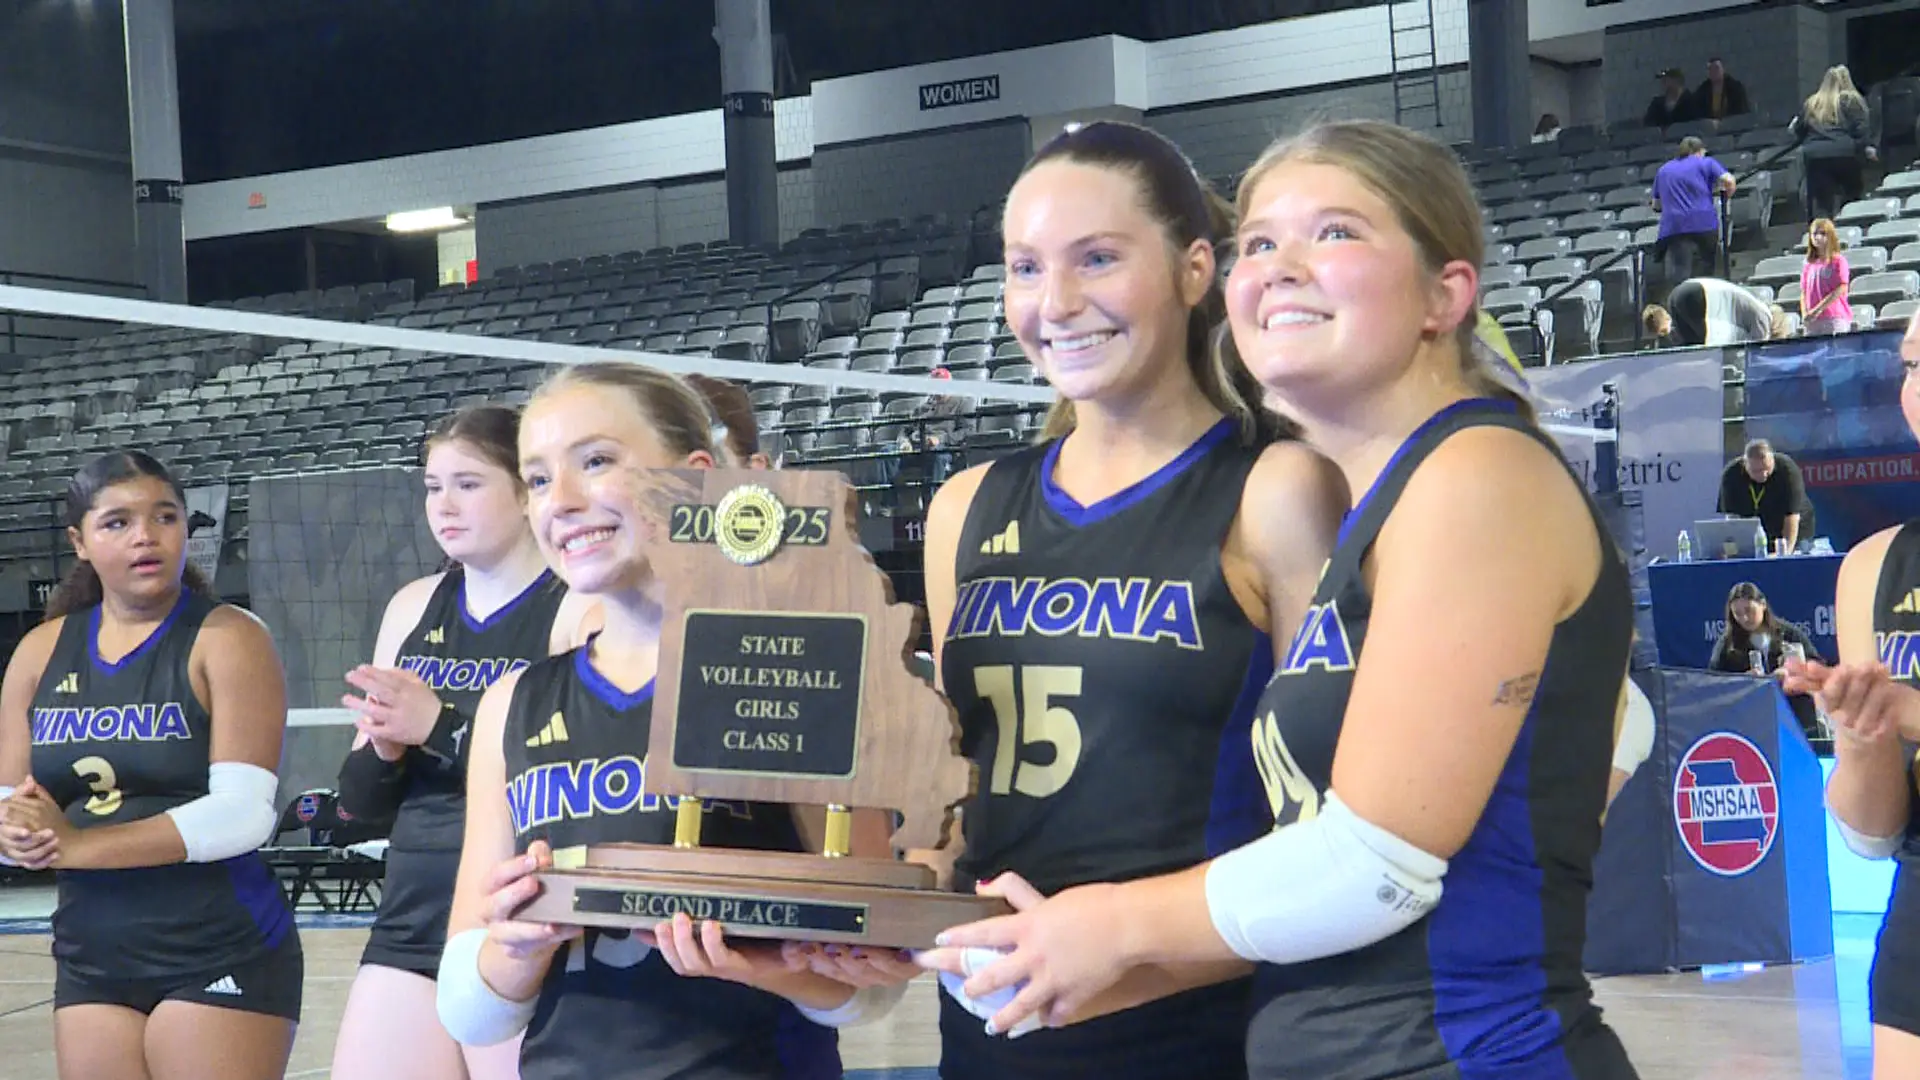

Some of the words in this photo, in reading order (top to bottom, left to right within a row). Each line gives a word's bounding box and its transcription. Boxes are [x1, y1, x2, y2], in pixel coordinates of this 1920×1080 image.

[922, 78, 997, 106] WOMEN
[740, 635, 806, 656] STATE
[700, 666, 842, 690] VOLLEYBALL
[31, 702, 193, 746] WINONA
[735, 699, 801, 720] GIRLS
[723, 730, 790, 752] CLASS
[796, 734, 804, 753] 1
[973, 664, 1084, 799] 15
[72, 756, 124, 816] 3
[1691, 788, 1760, 818] MSHSAA
[621, 893, 714, 918] SECOND
[719, 899, 800, 926] PLACE
